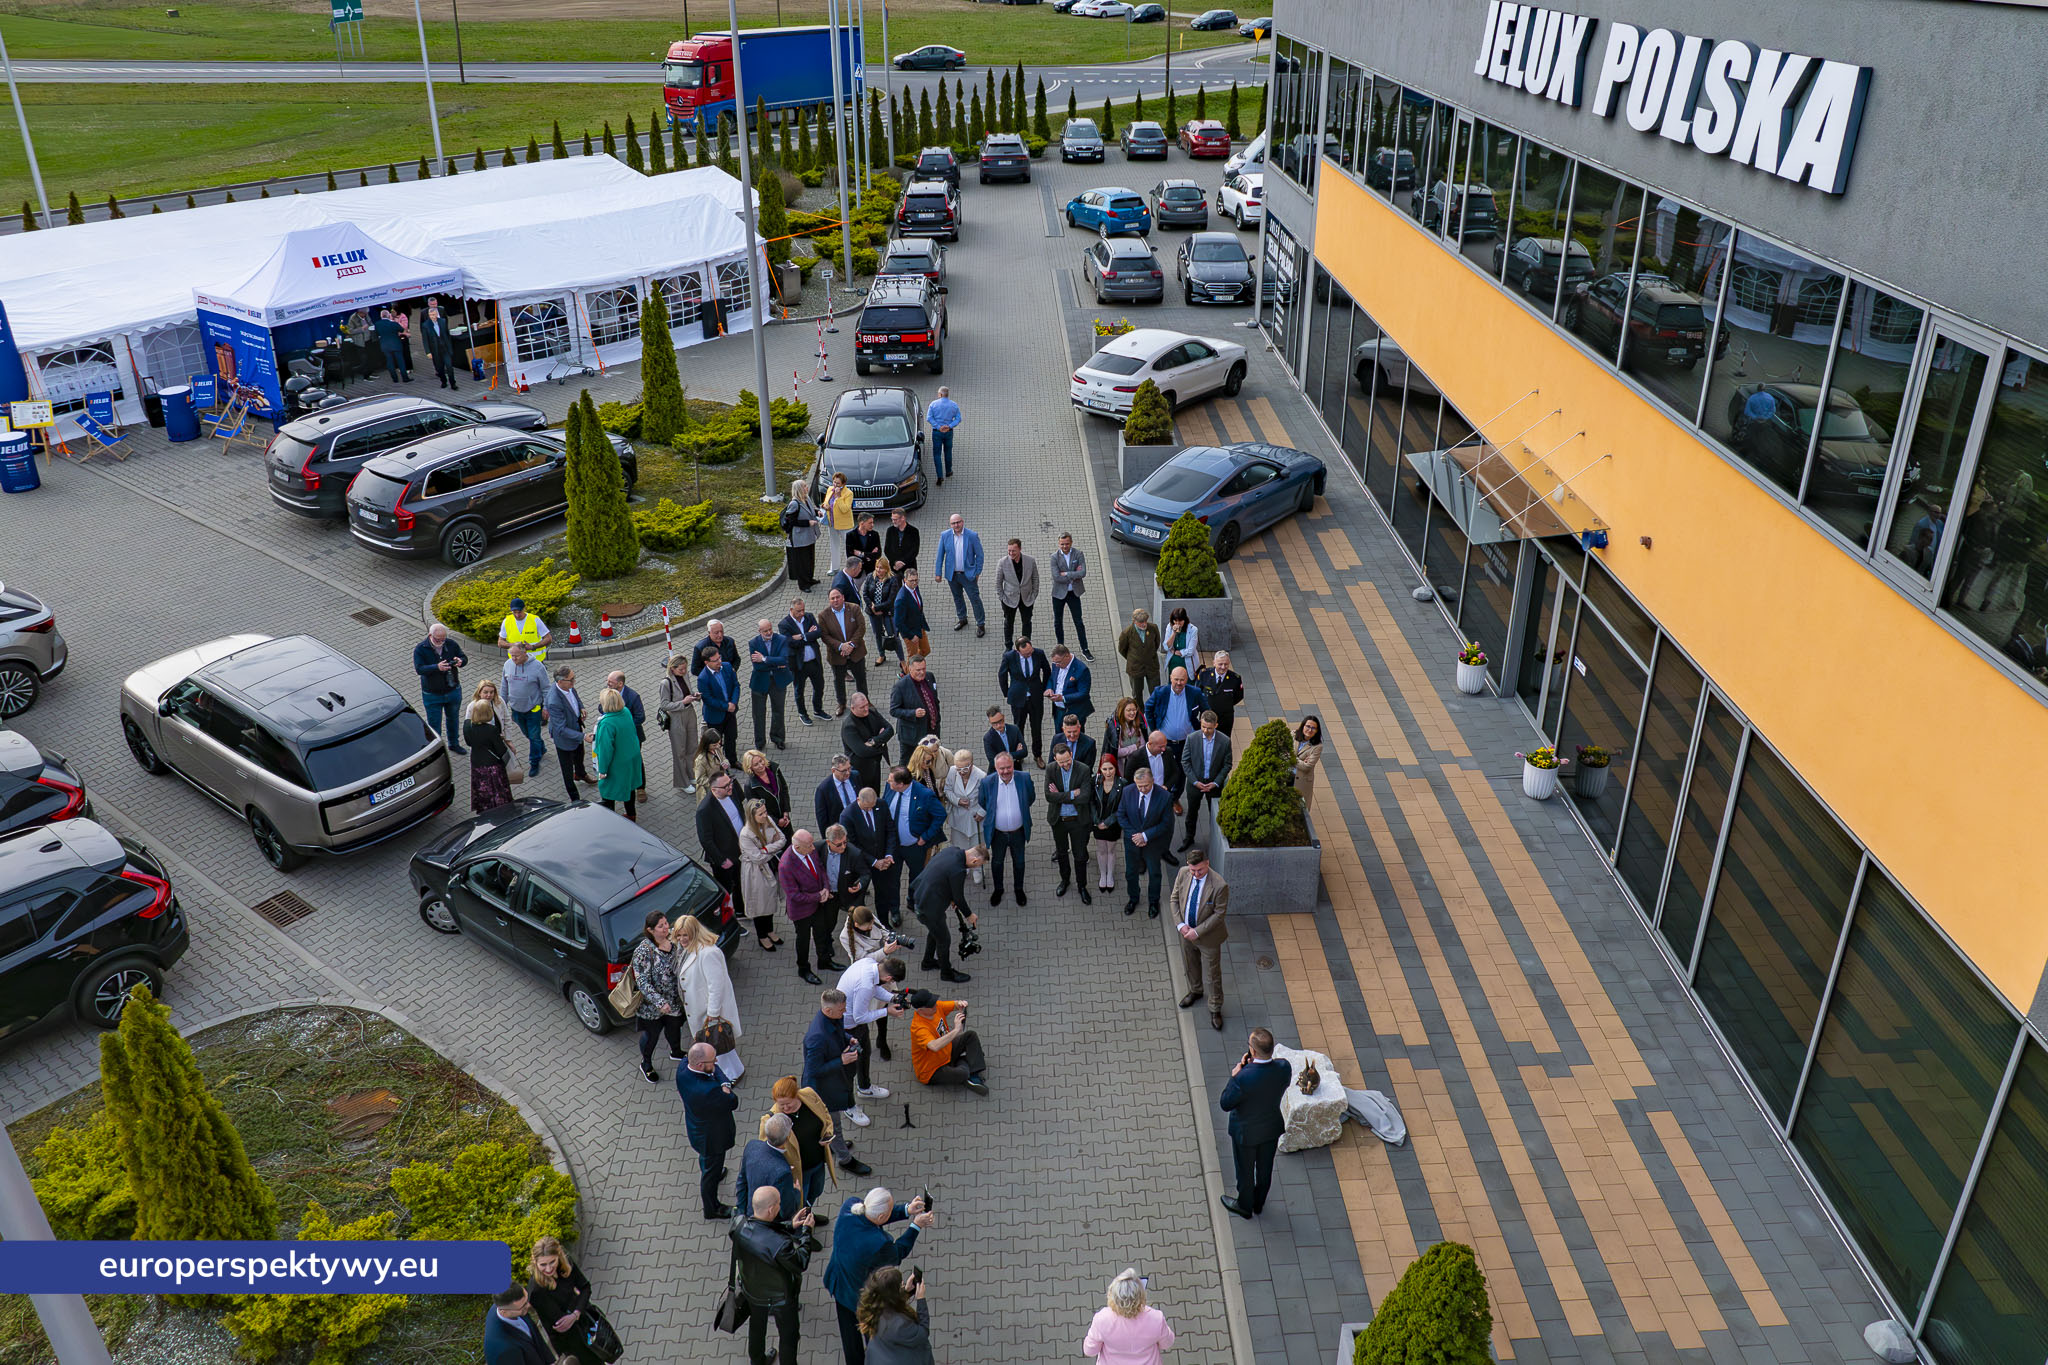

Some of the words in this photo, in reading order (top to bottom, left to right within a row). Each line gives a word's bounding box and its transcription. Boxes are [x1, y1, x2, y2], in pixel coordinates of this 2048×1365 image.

[1474, 0, 1597, 106] JELUX
[1592, 22, 1872, 194] POLSKA
[322, 249, 368, 267] JELUX
[338, 266, 365, 277] JELUX
[0, 442, 28, 454] JELUX
[375, 791, 388, 801] SK
[390, 778, 414, 795] 6F708
